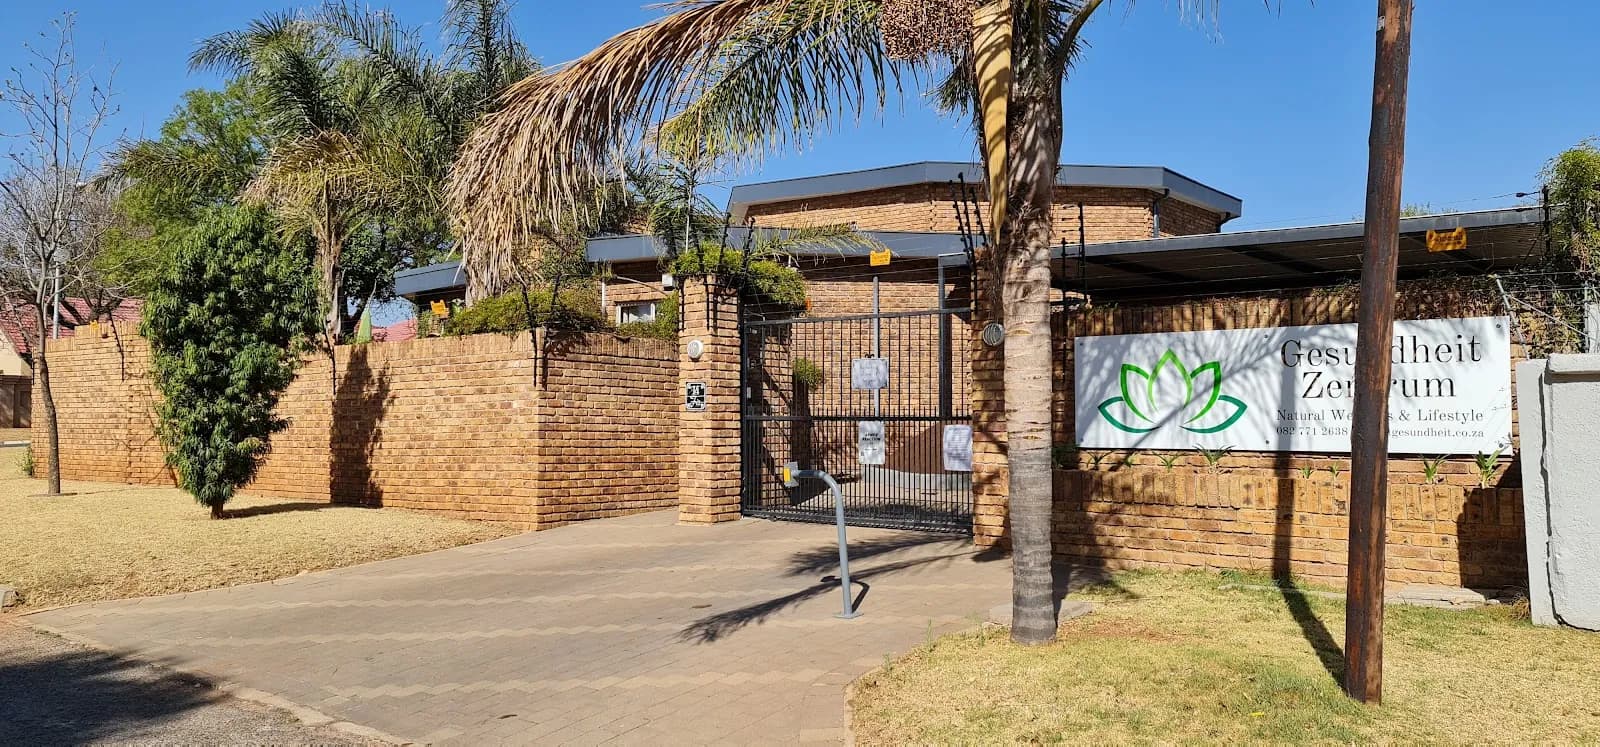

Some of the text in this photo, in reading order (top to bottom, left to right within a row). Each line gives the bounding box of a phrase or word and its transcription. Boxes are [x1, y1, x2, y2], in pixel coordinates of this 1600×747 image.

[1281, 334, 1482, 367] Gesudheit
[1302, 371, 1456, 399] Zeum
[1277, 409, 1325, 421] Natural
[1398, 409, 1410, 421] &
[1418, 408, 1483, 425] Lifestyle
[1276, 426, 1295, 436] 082
[1299, 426, 1316, 436] 771
[1391, 427, 1485, 439] gesundheit.co.za
